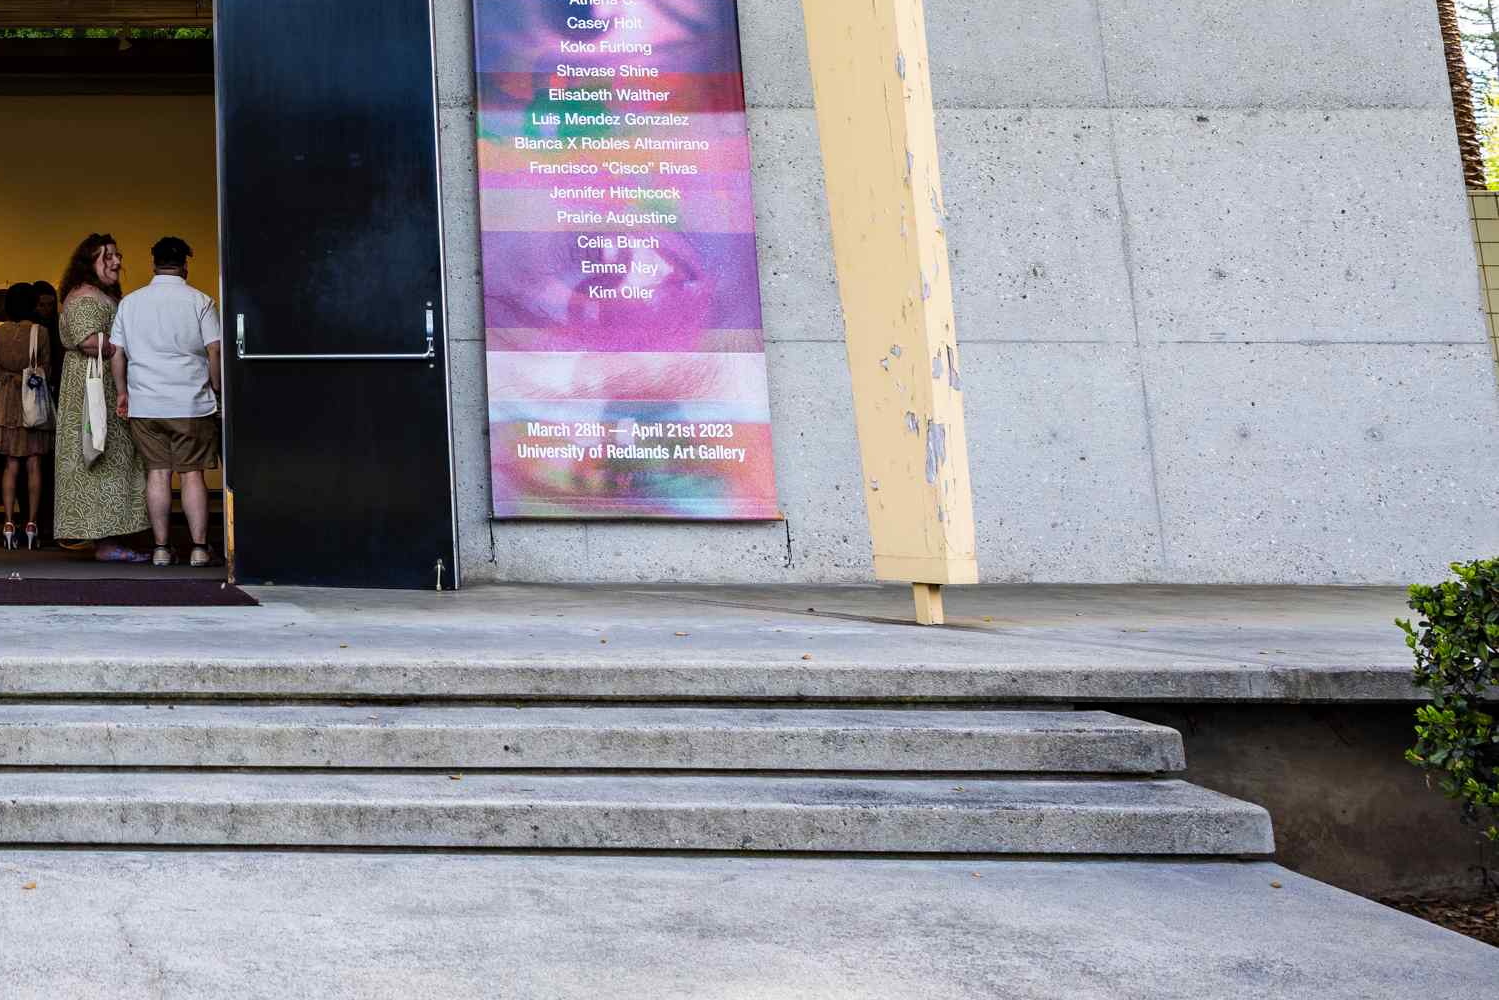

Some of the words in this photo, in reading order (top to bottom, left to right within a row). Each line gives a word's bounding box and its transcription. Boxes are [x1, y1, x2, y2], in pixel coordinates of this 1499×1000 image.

[566, 17, 610, 32] Casey
[614, 16, 643, 29] Holt
[560, 40, 596, 53] Koko
[599, 40, 652, 56] Furlong
[556, 64, 616, 77] Shavase
[619, 64, 658, 77] Shine
[549, 88, 612, 101] Elisabeth
[616, 88, 670, 102] Walther
[532, 112, 561, 126] Luis
[565, 112, 621, 126] Mendez
[625, 112, 689, 126] Gonzalez
[515, 137, 563, 151] Blanca
[567, 137, 577, 150] X
[581, 137, 630, 151] Robles
[634, 137, 709, 151] Altamirano
[529, 161, 598, 175] Francisco
[659, 162, 697, 175] Rivas
[549, 186, 606, 200] Jennifer
[610, 186, 681, 200] Hitchcock
[557, 211, 602, 224] Prairie
[606, 211, 677, 227] Augustine
[577, 235, 613, 249] Celia
[617, 236, 659, 249] Burch
[581, 261, 627, 274] Emma
[631, 261, 659, 277] Nay
[589, 286, 617, 299] Kim
[621, 286, 654, 299] Oller
[528, 422, 571, 438] March
[574, 422, 605, 438] 28th
[631, 423, 663, 439] April
[666, 423, 696, 438] 21st
[699, 424, 733, 438] 2023
[517, 444, 585, 462] University
[589, 444, 604, 459] of
[607, 444, 669, 460] Redlands
[673, 445, 695, 460] Art
[698, 445, 746, 462] Gallery
